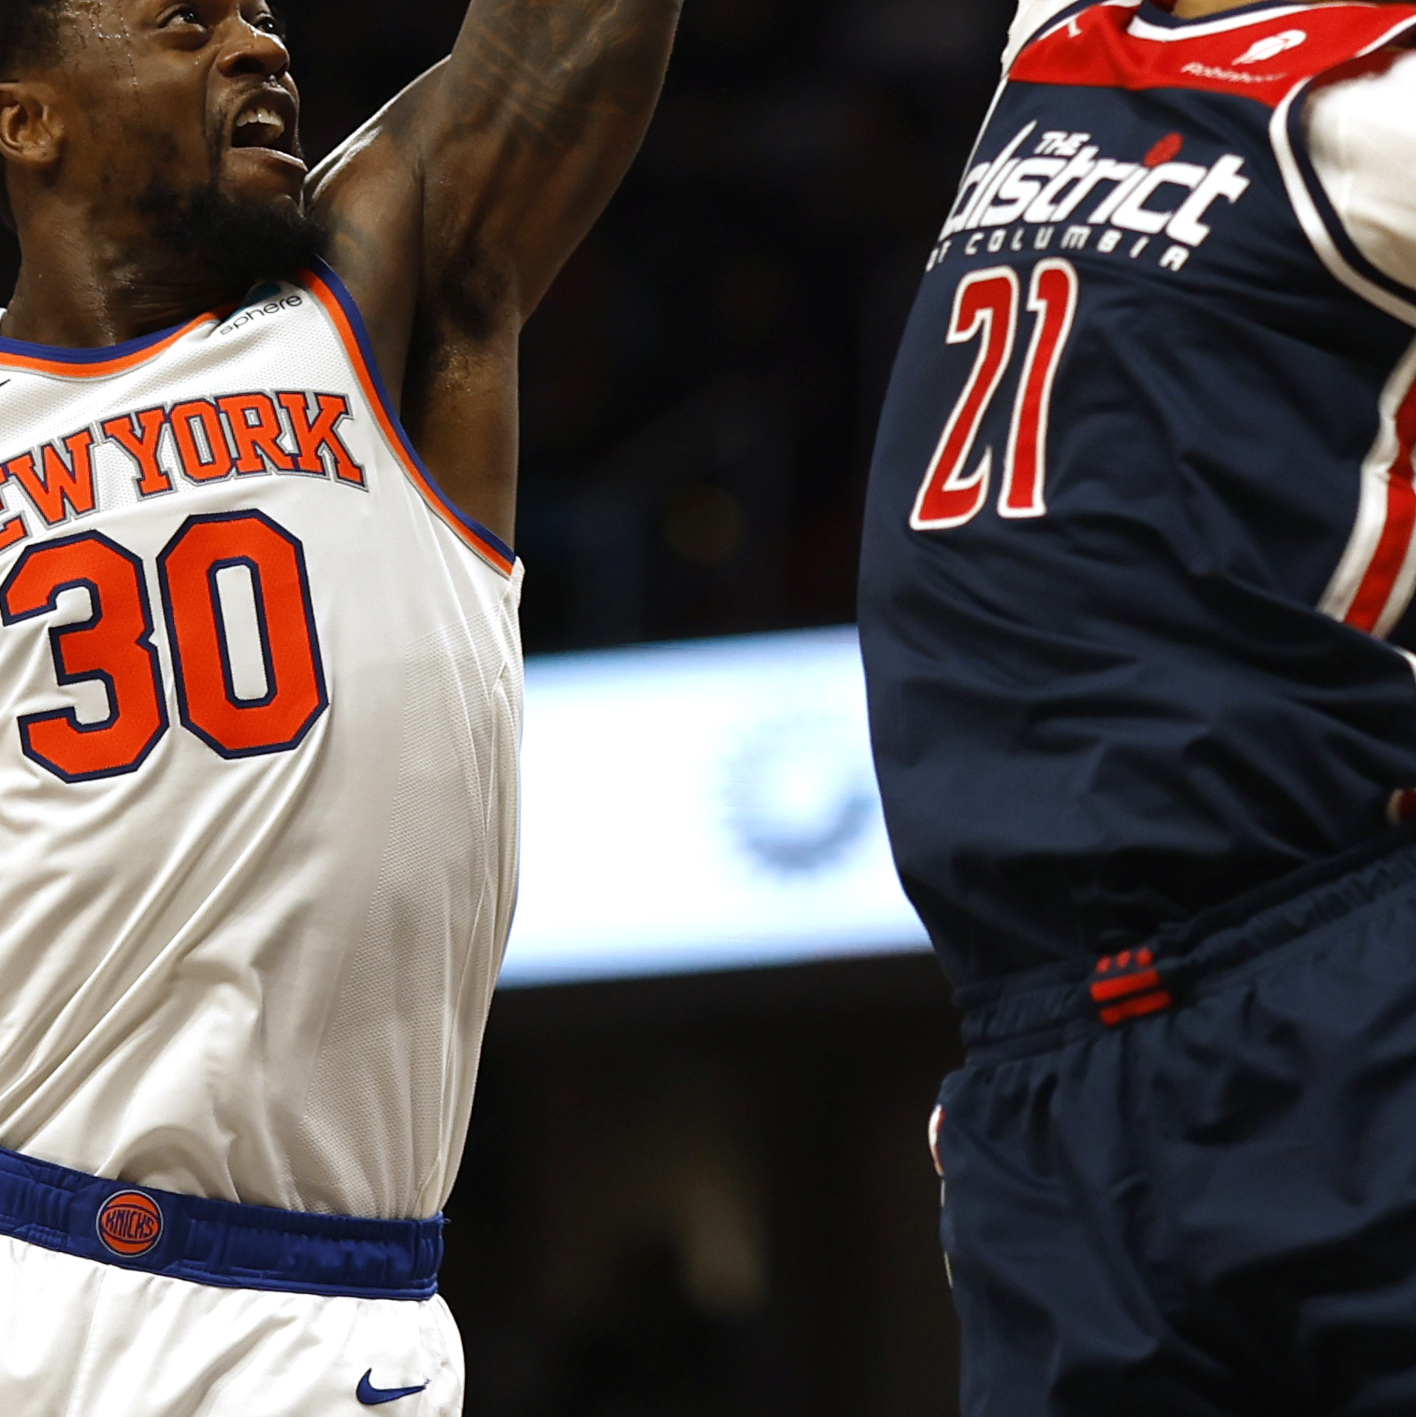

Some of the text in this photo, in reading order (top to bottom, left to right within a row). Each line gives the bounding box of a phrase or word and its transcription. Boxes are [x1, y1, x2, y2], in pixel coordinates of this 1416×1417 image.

[1033, 130, 1091, 156] THE
[938, 119, 1250, 247] district
[965, 226, 1190, 271] COLUMBIA
[219, 295, 303, 336] sphere
[909, 257, 1078, 531] 21
[103, 388, 370, 501] YORK
[105, 1208, 154, 1240] KNICKS
